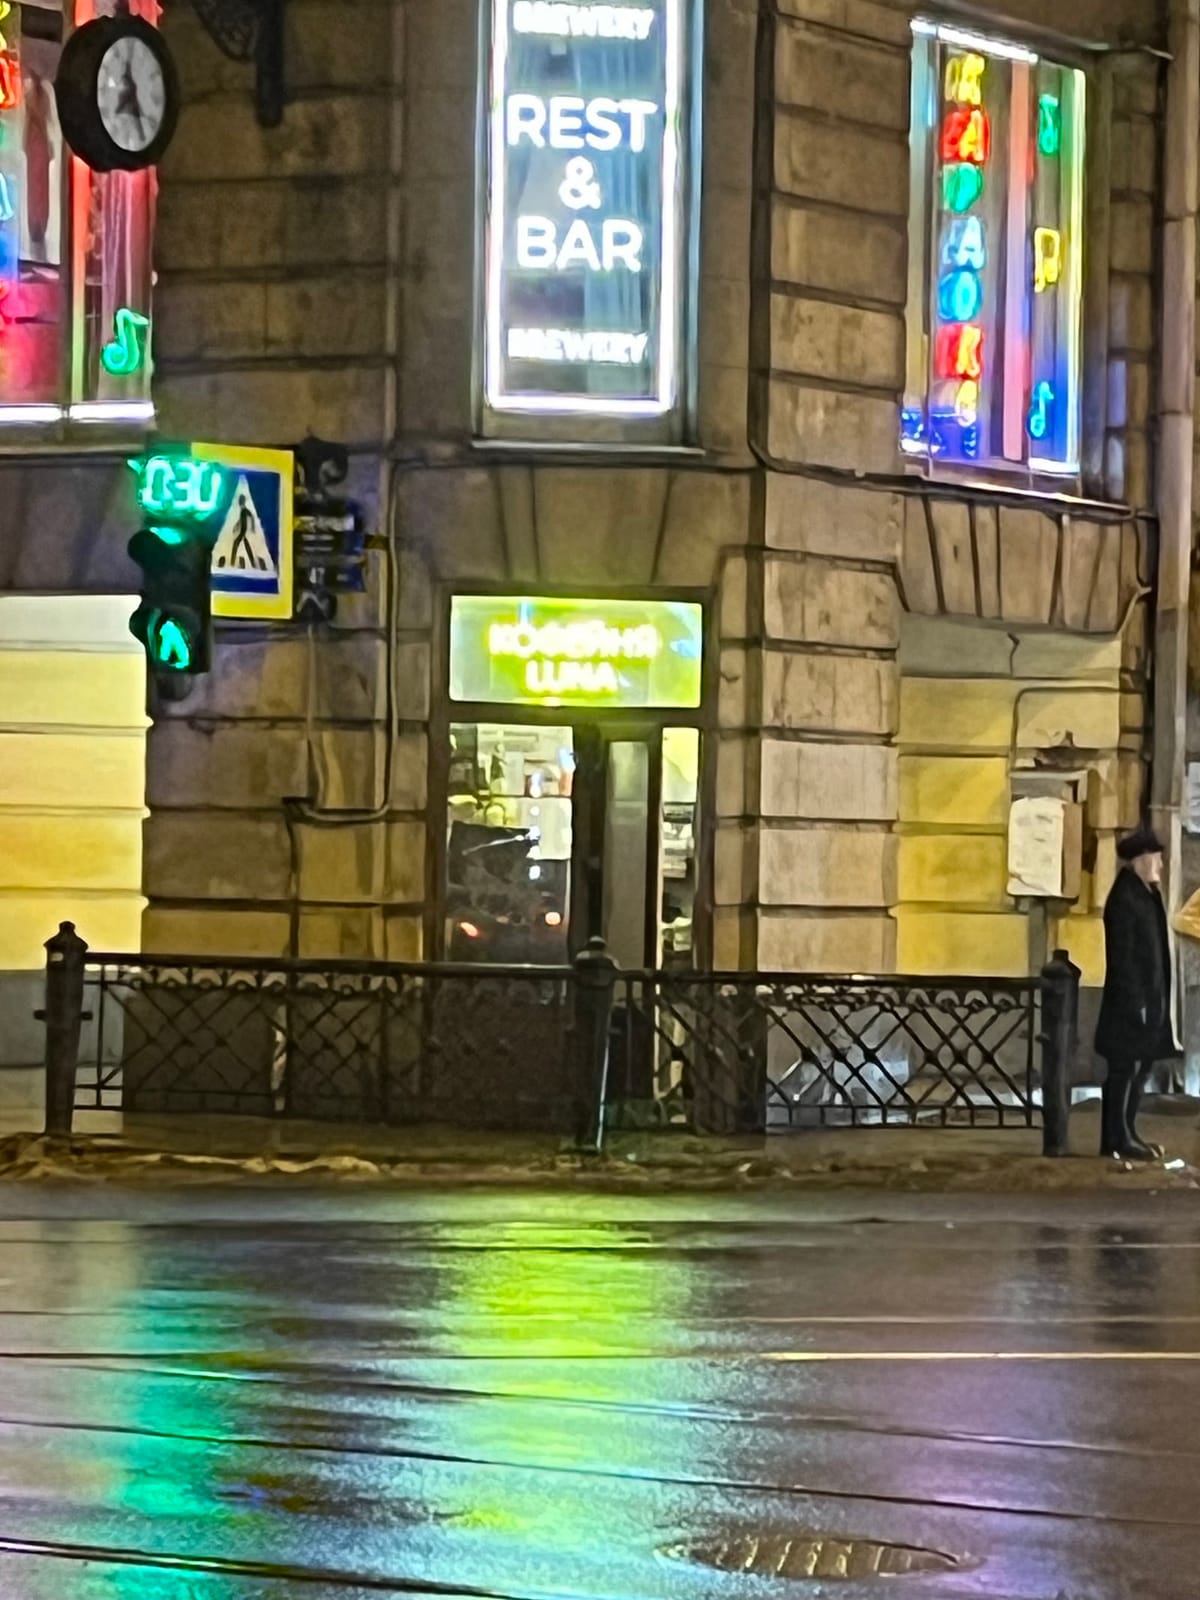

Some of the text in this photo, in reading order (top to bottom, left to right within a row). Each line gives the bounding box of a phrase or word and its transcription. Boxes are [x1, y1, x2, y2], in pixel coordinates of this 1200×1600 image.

[507, 95, 658, 152] REST
[559, 156, 601, 209] &
[516, 215, 643, 272] BAR
